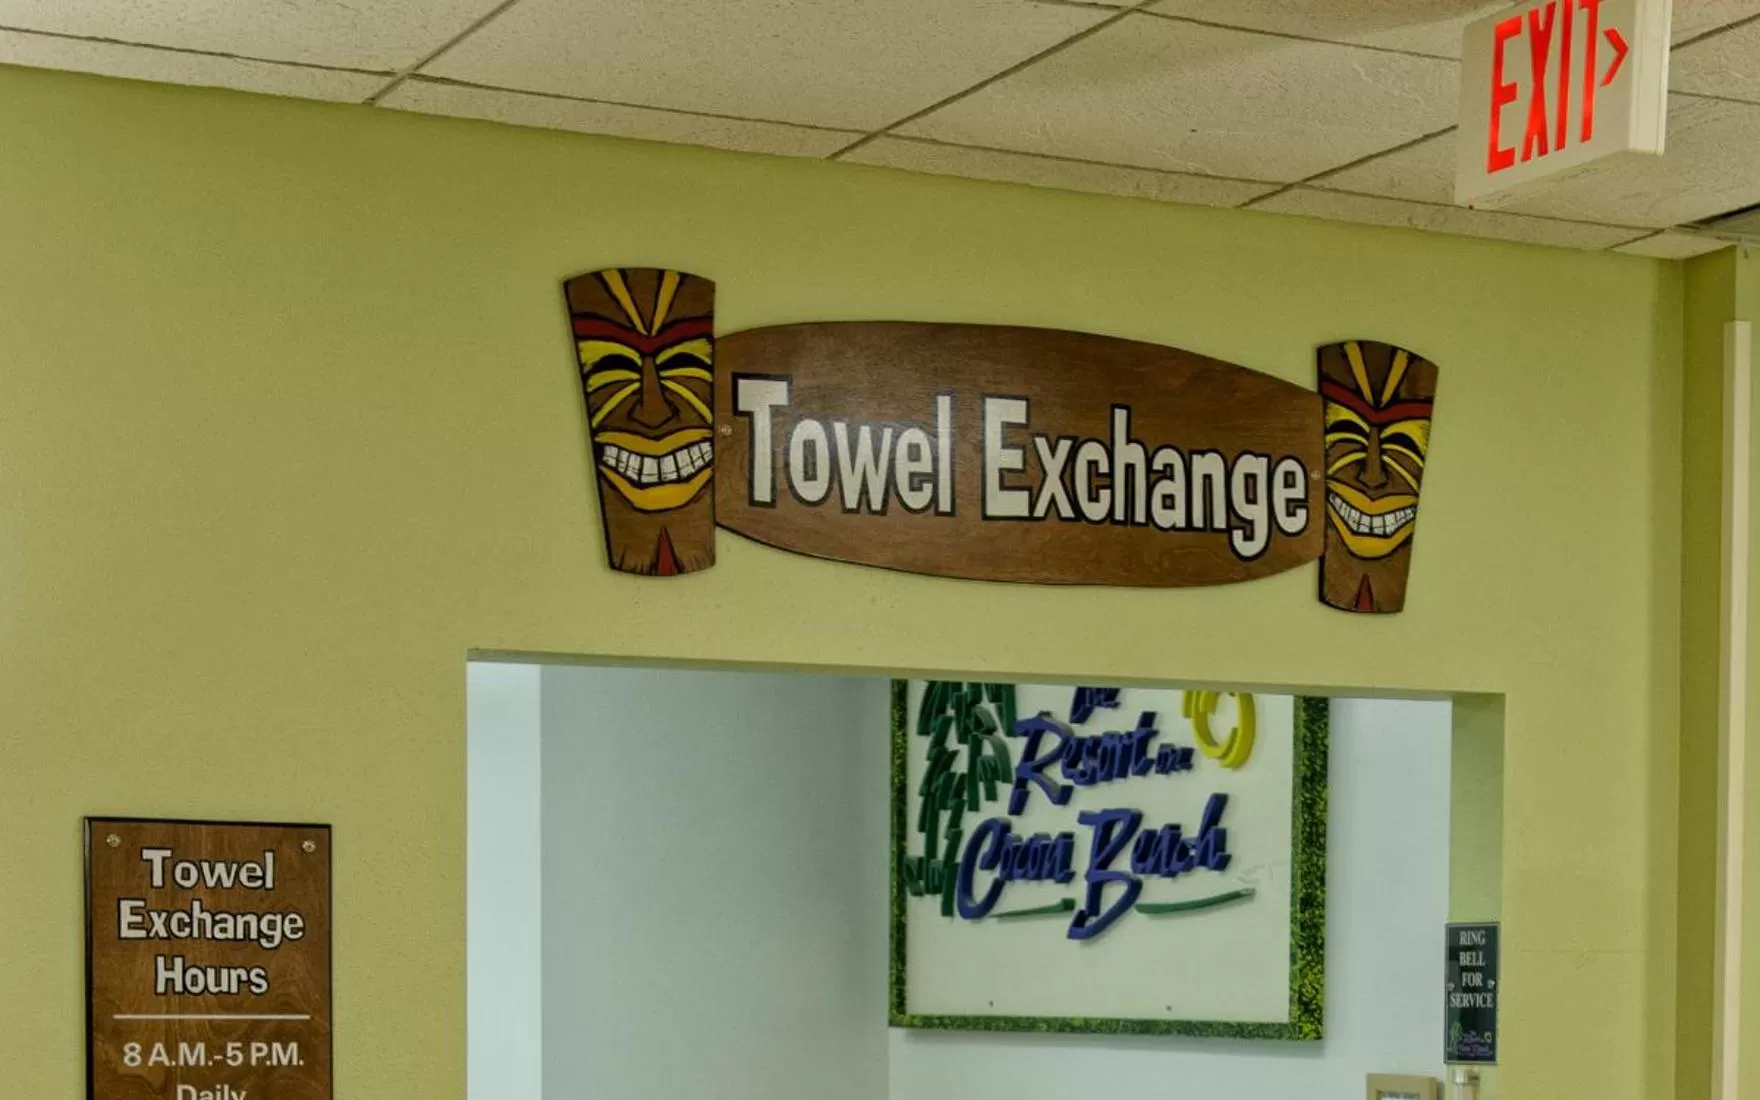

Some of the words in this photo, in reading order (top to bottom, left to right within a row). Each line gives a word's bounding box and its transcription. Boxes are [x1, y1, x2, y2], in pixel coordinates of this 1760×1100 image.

[1487, 0, 1600, 173] EXIT
[732, 373, 954, 517] Towel
[982, 396, 1313, 560] Exchange
[1008, 711, 1159, 816] Resort
[141, 848, 275, 890] Towel
[957, 817, 1076, 920] Cocoa
[1067, 793, 1231, 940] Beach
[118, 898, 304, 949] Exchange
[1460, 930, 1486, 945] RING
[155, 955, 269, 995] Hours
[1459, 951, 1486, 966] BELL
[1461, 972, 1483, 987] FOR
[1449, 993, 1494, 1008] SERVICE
[123, 1042, 142, 1067] 8
[251, 1042, 304, 1067] P.M.
